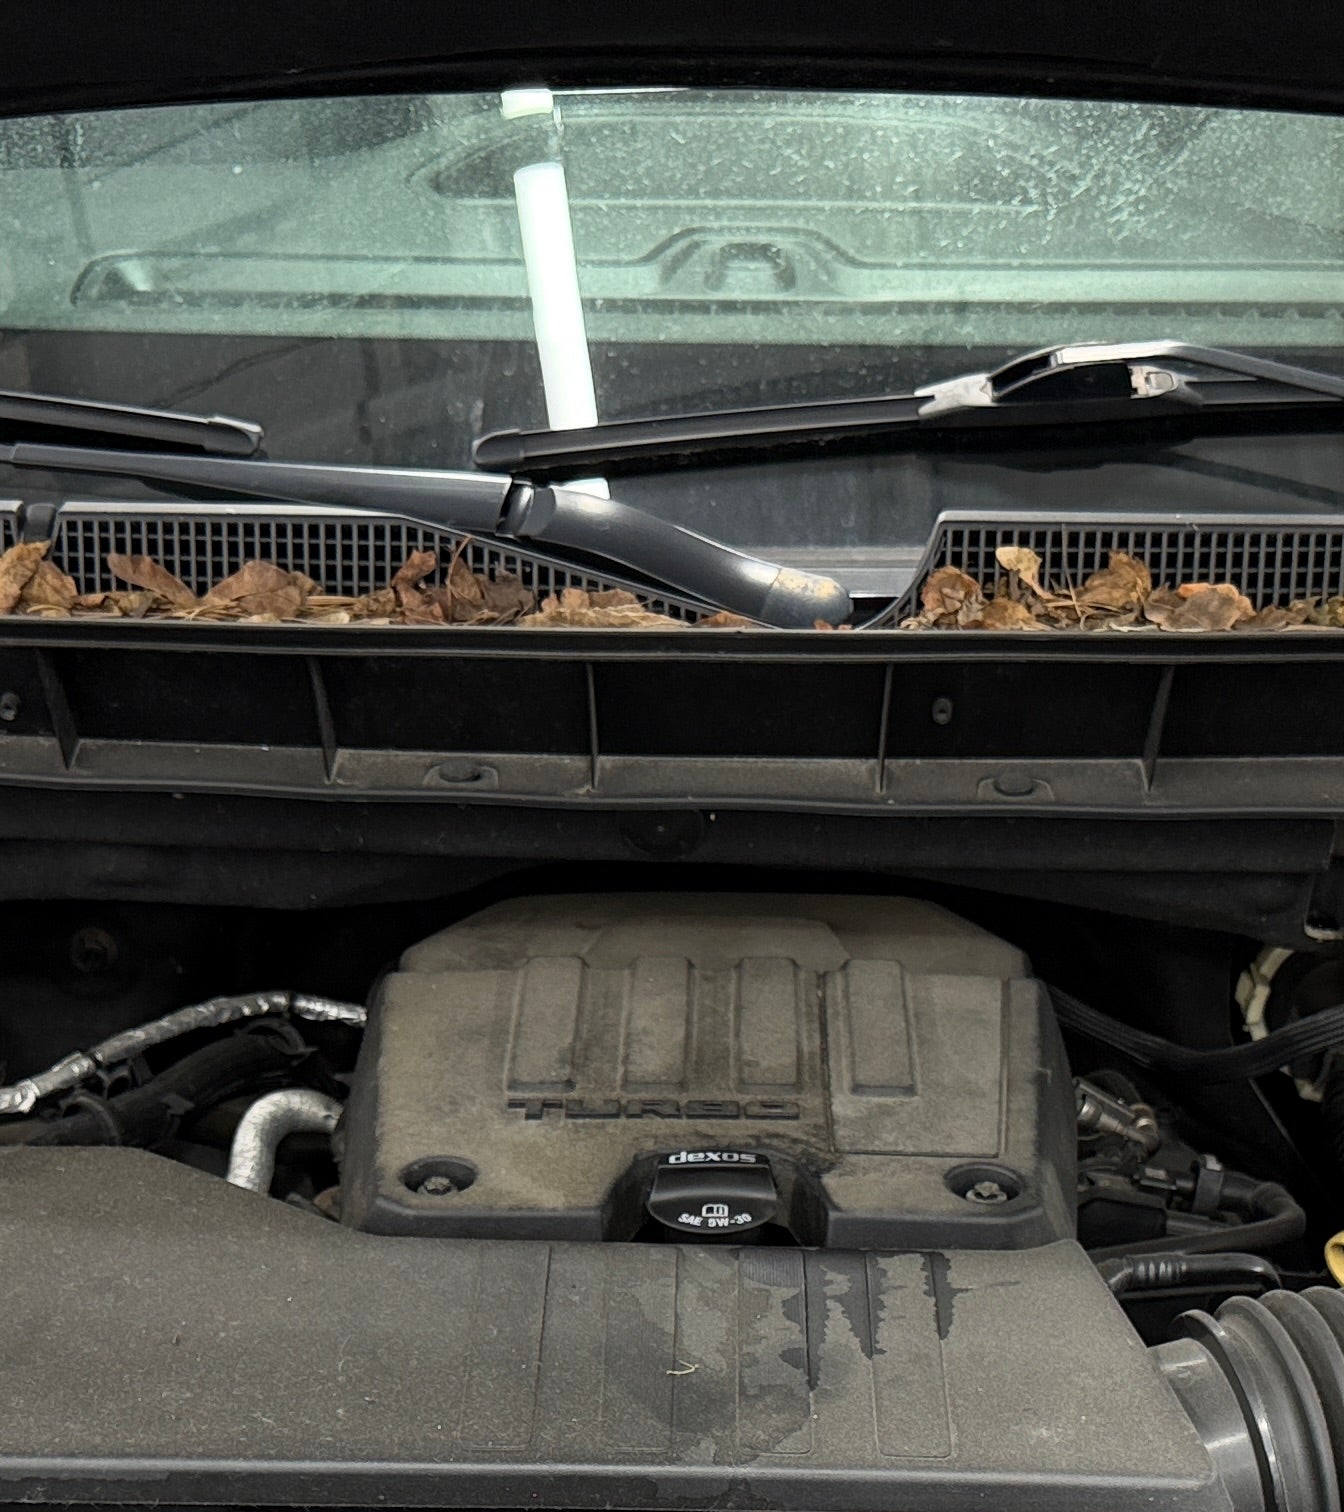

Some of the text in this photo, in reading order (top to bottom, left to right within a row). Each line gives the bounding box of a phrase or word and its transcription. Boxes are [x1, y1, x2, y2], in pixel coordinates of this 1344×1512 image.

[507, 1098, 801, 1121] TURBO
[668, 1150, 756, 1165] dexos
[677, 1212, 752, 1228] SAE 5W-30
